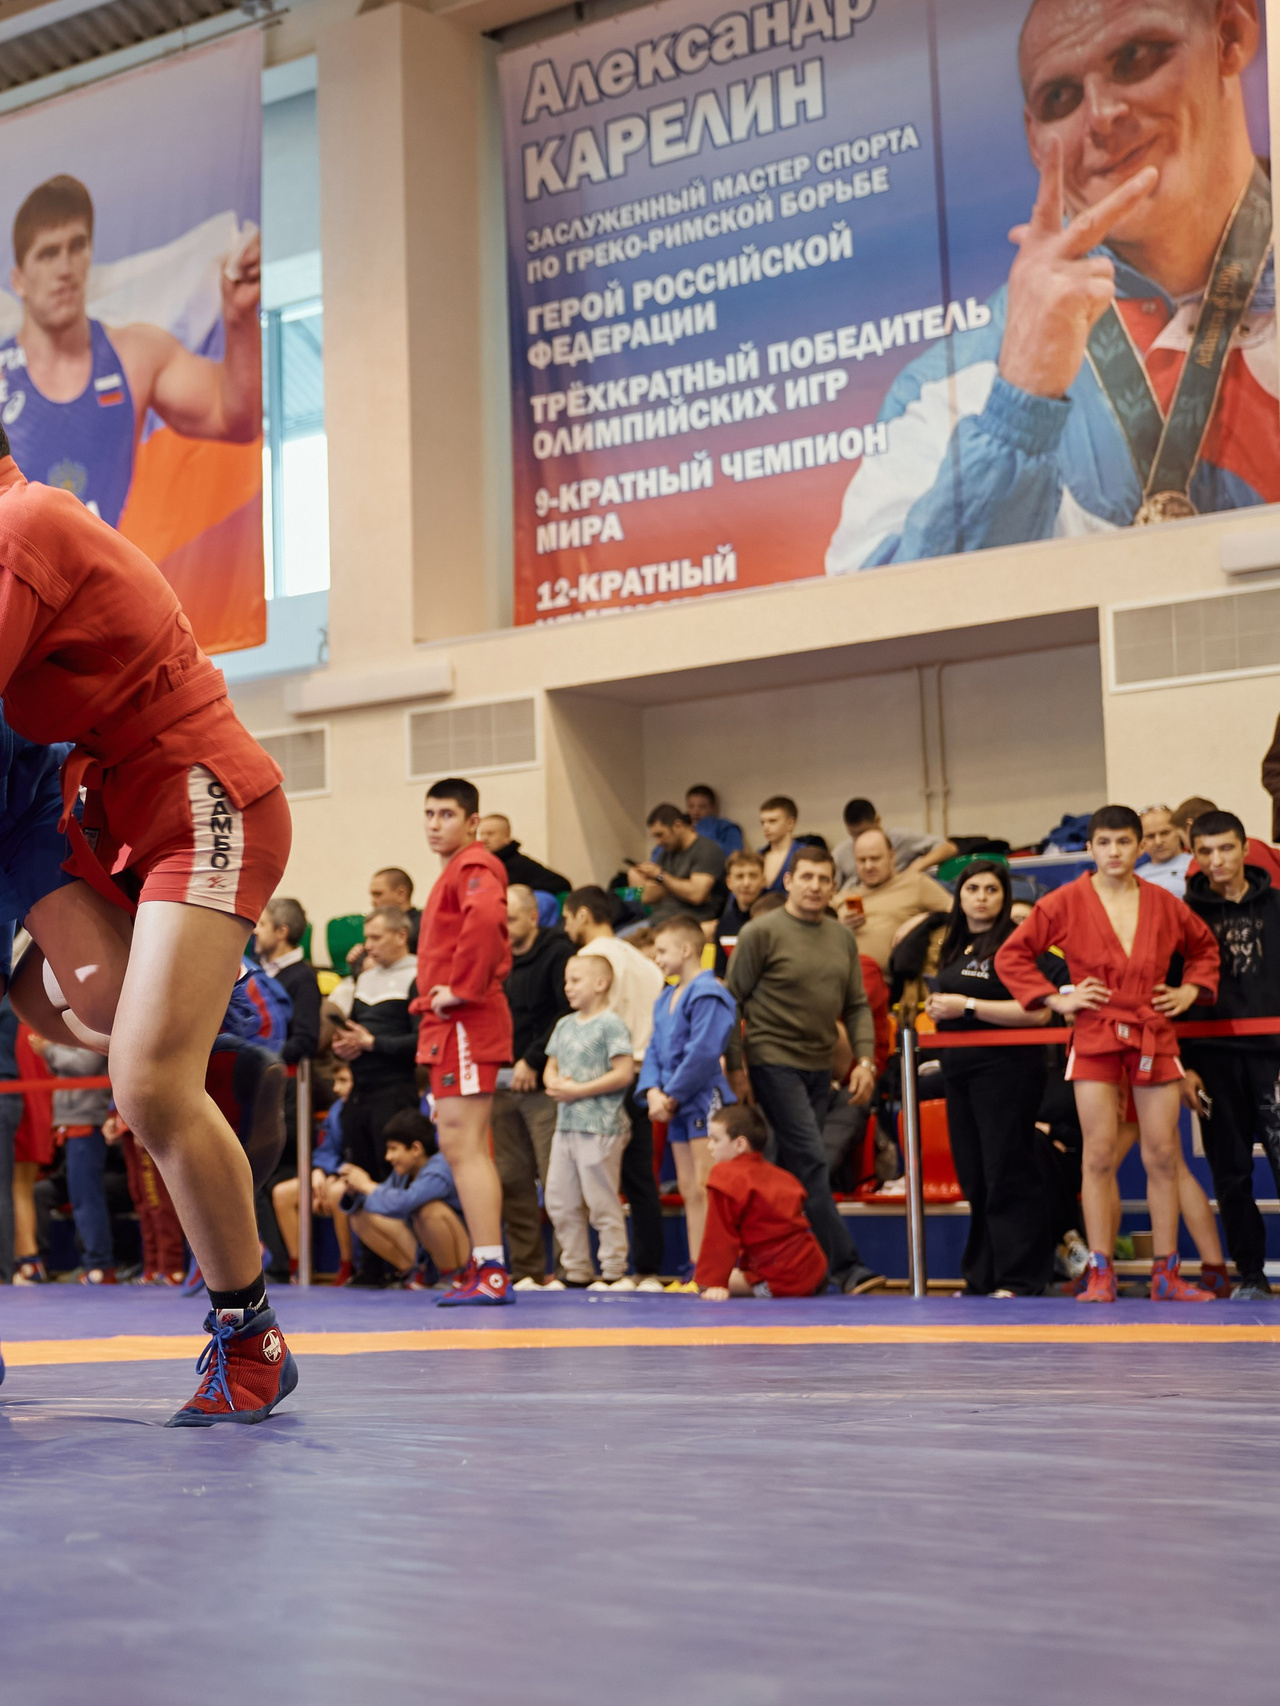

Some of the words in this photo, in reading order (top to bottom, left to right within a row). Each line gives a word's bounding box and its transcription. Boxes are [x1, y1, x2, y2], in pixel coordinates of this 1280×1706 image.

[522, 0, 875, 123] Александр
[523, 59, 825, 201] КАРЕЛИН
[526, 178, 706, 253] ЗАСЛУЖЕННЫЙ
[712, 156, 810, 203] МАСТЕР
[817, 124, 919, 173] СПОРТА
[526, 254, 560, 284] ПО
[566, 195, 774, 276] ГРЕКО-РИМСКОЙ
[780, 167, 889, 214] БОРЬБЕ
[527, 281, 625, 335] ГЕРОЙ
[632, 221, 854, 312] РОССИЙСКОЙ
[527, 302, 717, 370] ФЕДЕРАЦИИ
[530, 342, 759, 424] ТРЁХКРАТНЫЙ
[767, 298, 992, 373] ПОБЕДИТЕЛЬ
[532, 386, 778, 460] ОЛИМПИЙСКИХ
[784, 368, 849, 411] ИГР
[535, 449, 713, 517] 9-КРАТНЫЙ
[719, 421, 888, 483] ЧЕМПИОН
[536, 512, 624, 555] МИРА
[536, 543, 737, 611] 12-КРАТНЫЙ
[207, 782, 233, 869] САМБО
